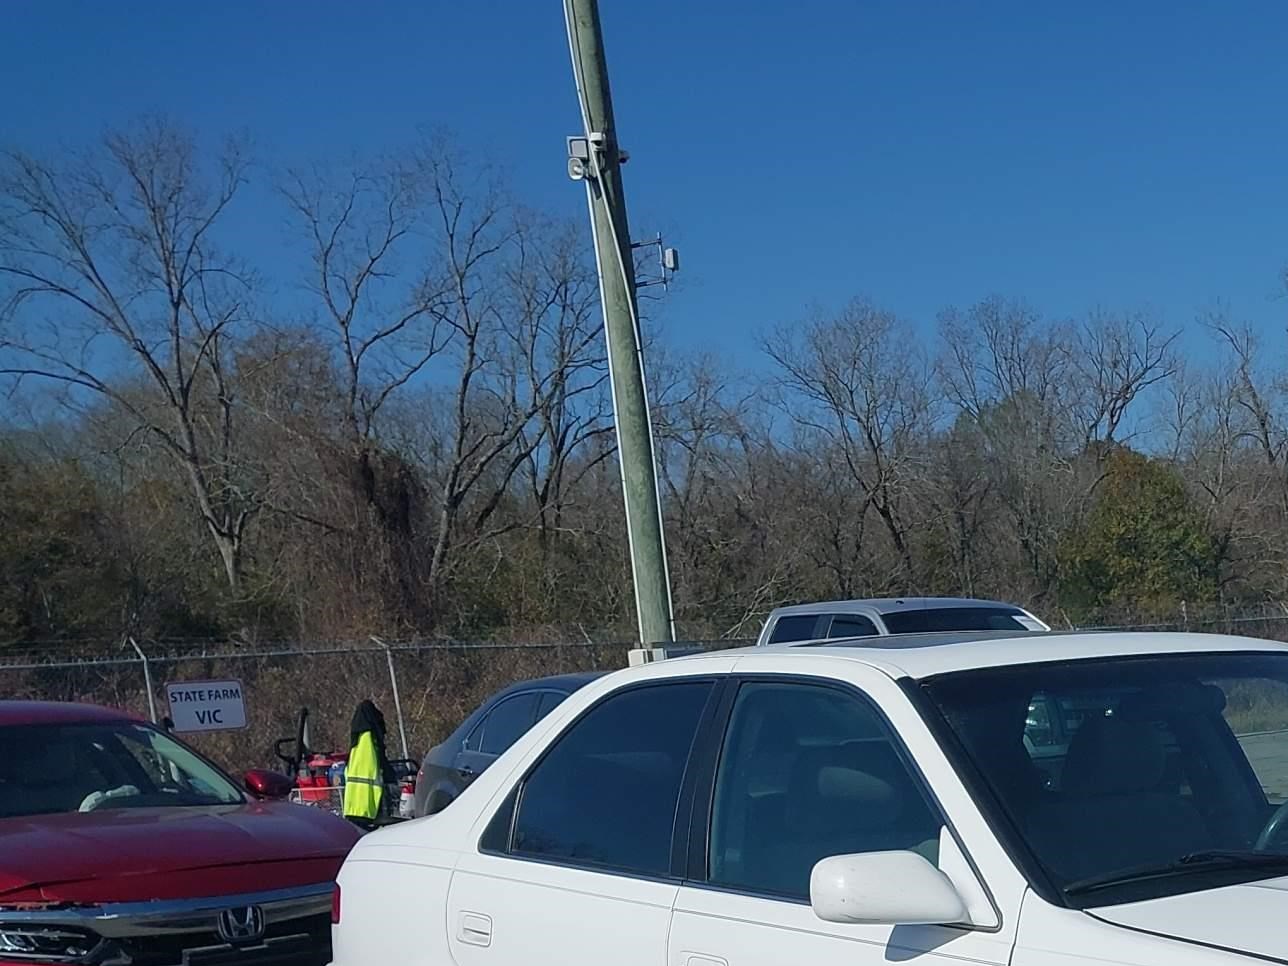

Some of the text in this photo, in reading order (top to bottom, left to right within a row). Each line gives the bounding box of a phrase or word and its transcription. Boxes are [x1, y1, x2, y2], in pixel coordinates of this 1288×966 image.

[170, 688, 241, 703] STATE FARM
[195, 709, 224, 725] VIC
